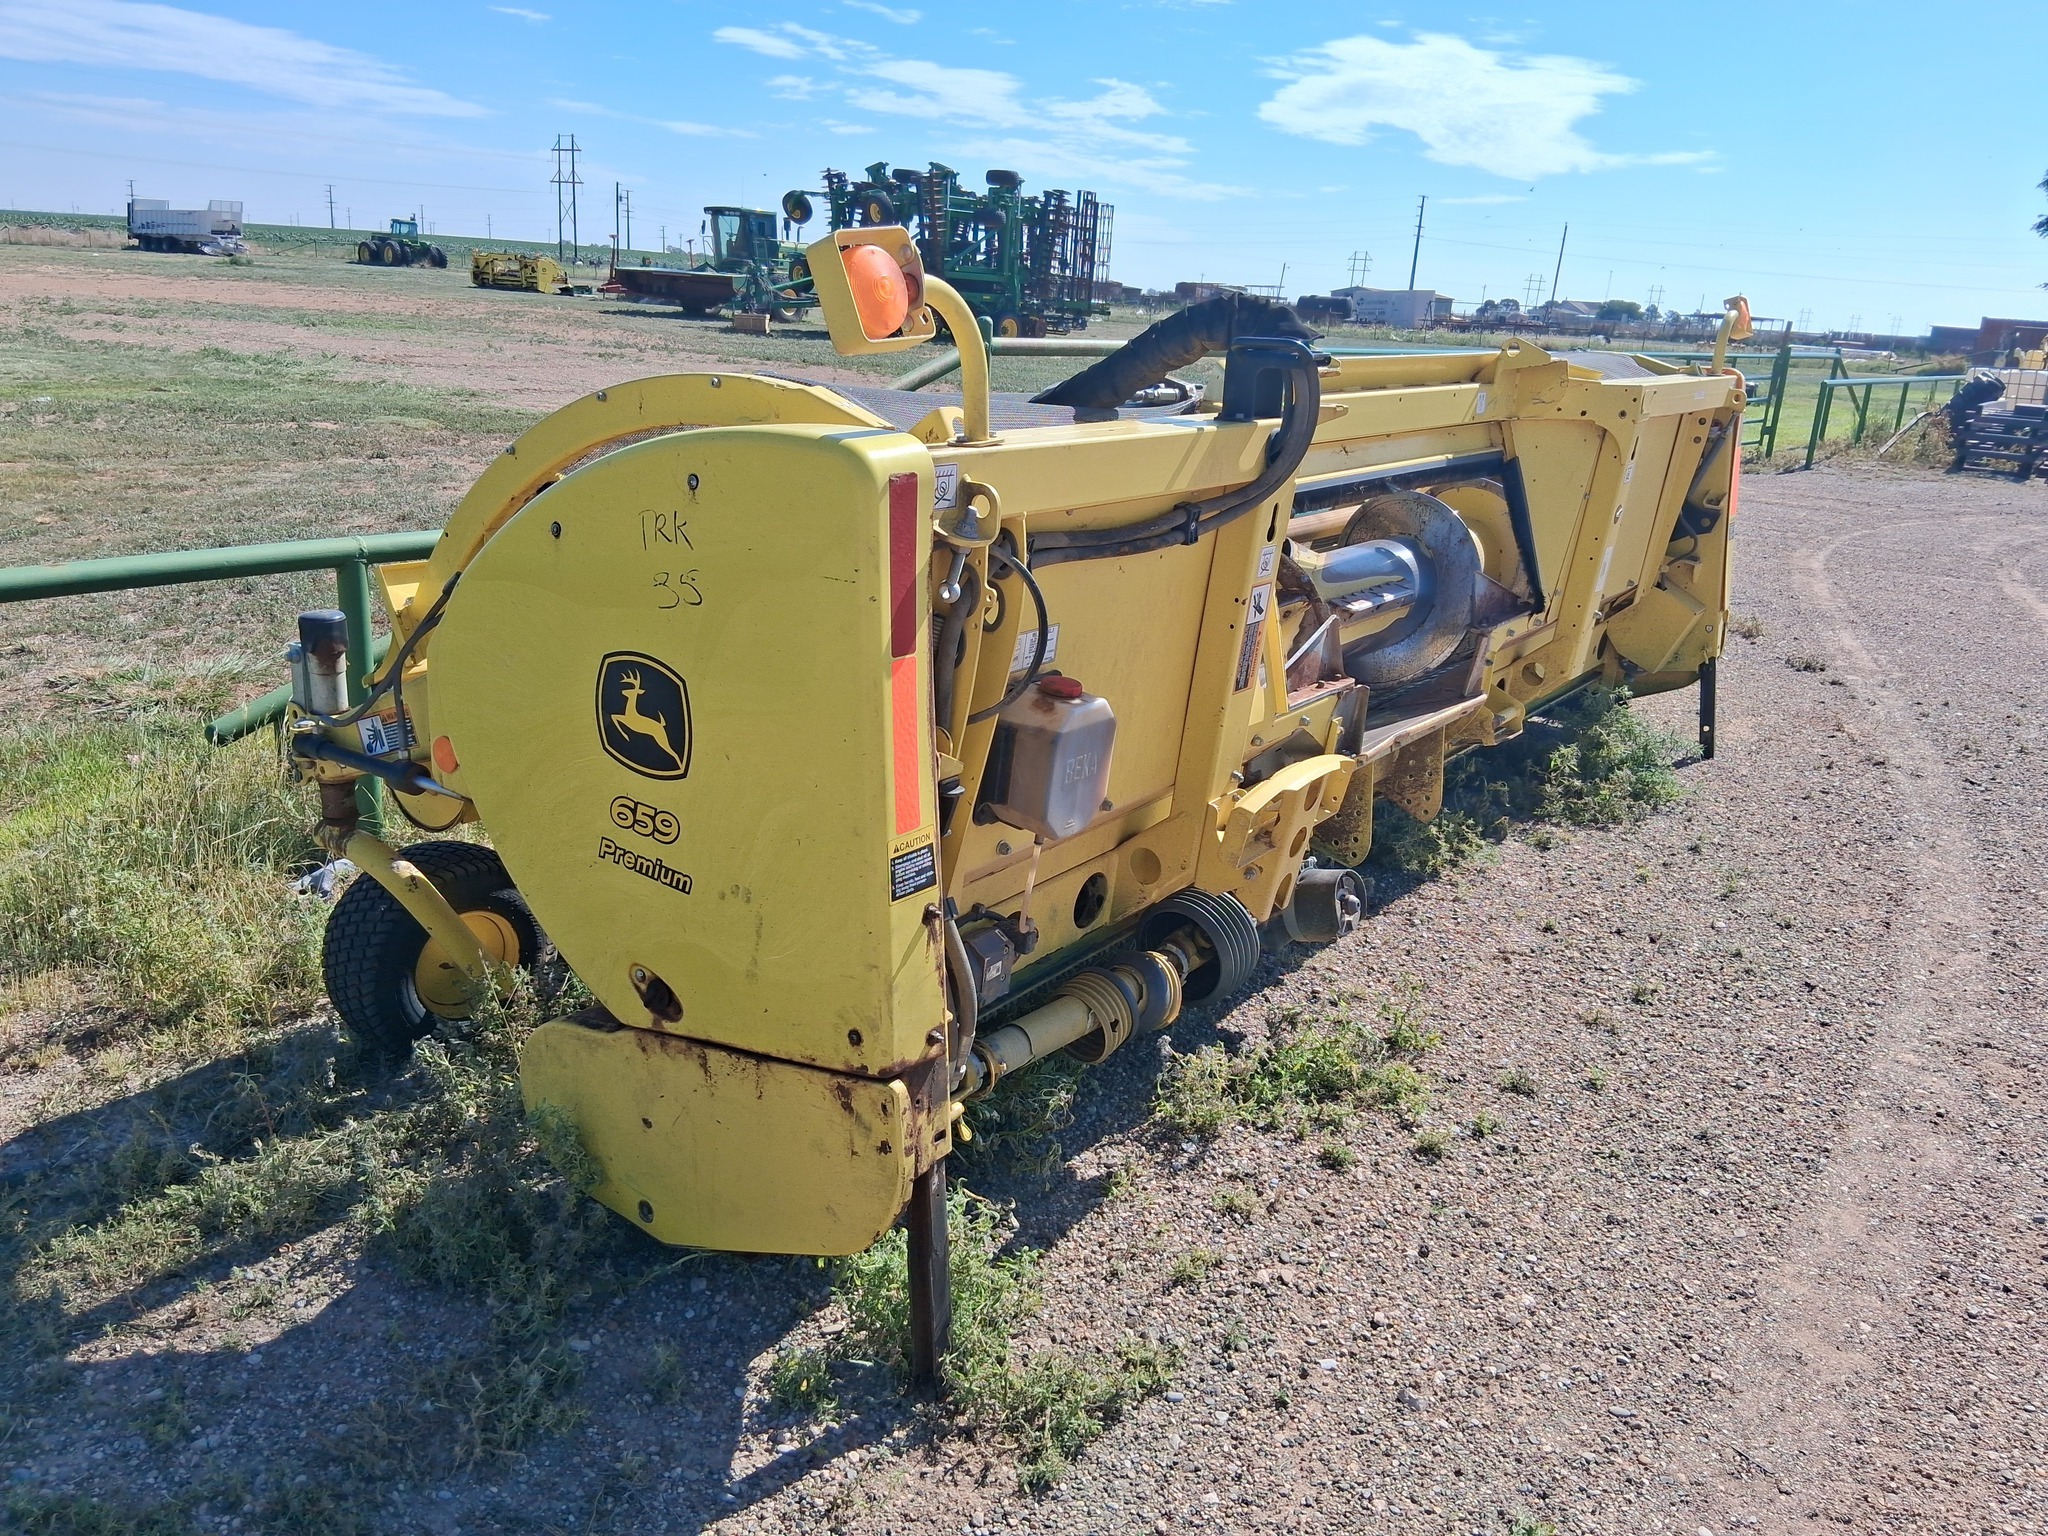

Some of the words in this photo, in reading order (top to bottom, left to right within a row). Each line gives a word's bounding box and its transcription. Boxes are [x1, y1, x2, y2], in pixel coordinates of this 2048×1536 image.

[653, 569, 703, 609] 35
[1065, 751, 1098, 784] BEKA
[609, 795, 681, 845] 659
[900, 832, 931, 851] CAUTION
[598, 836, 693, 895] Premium
